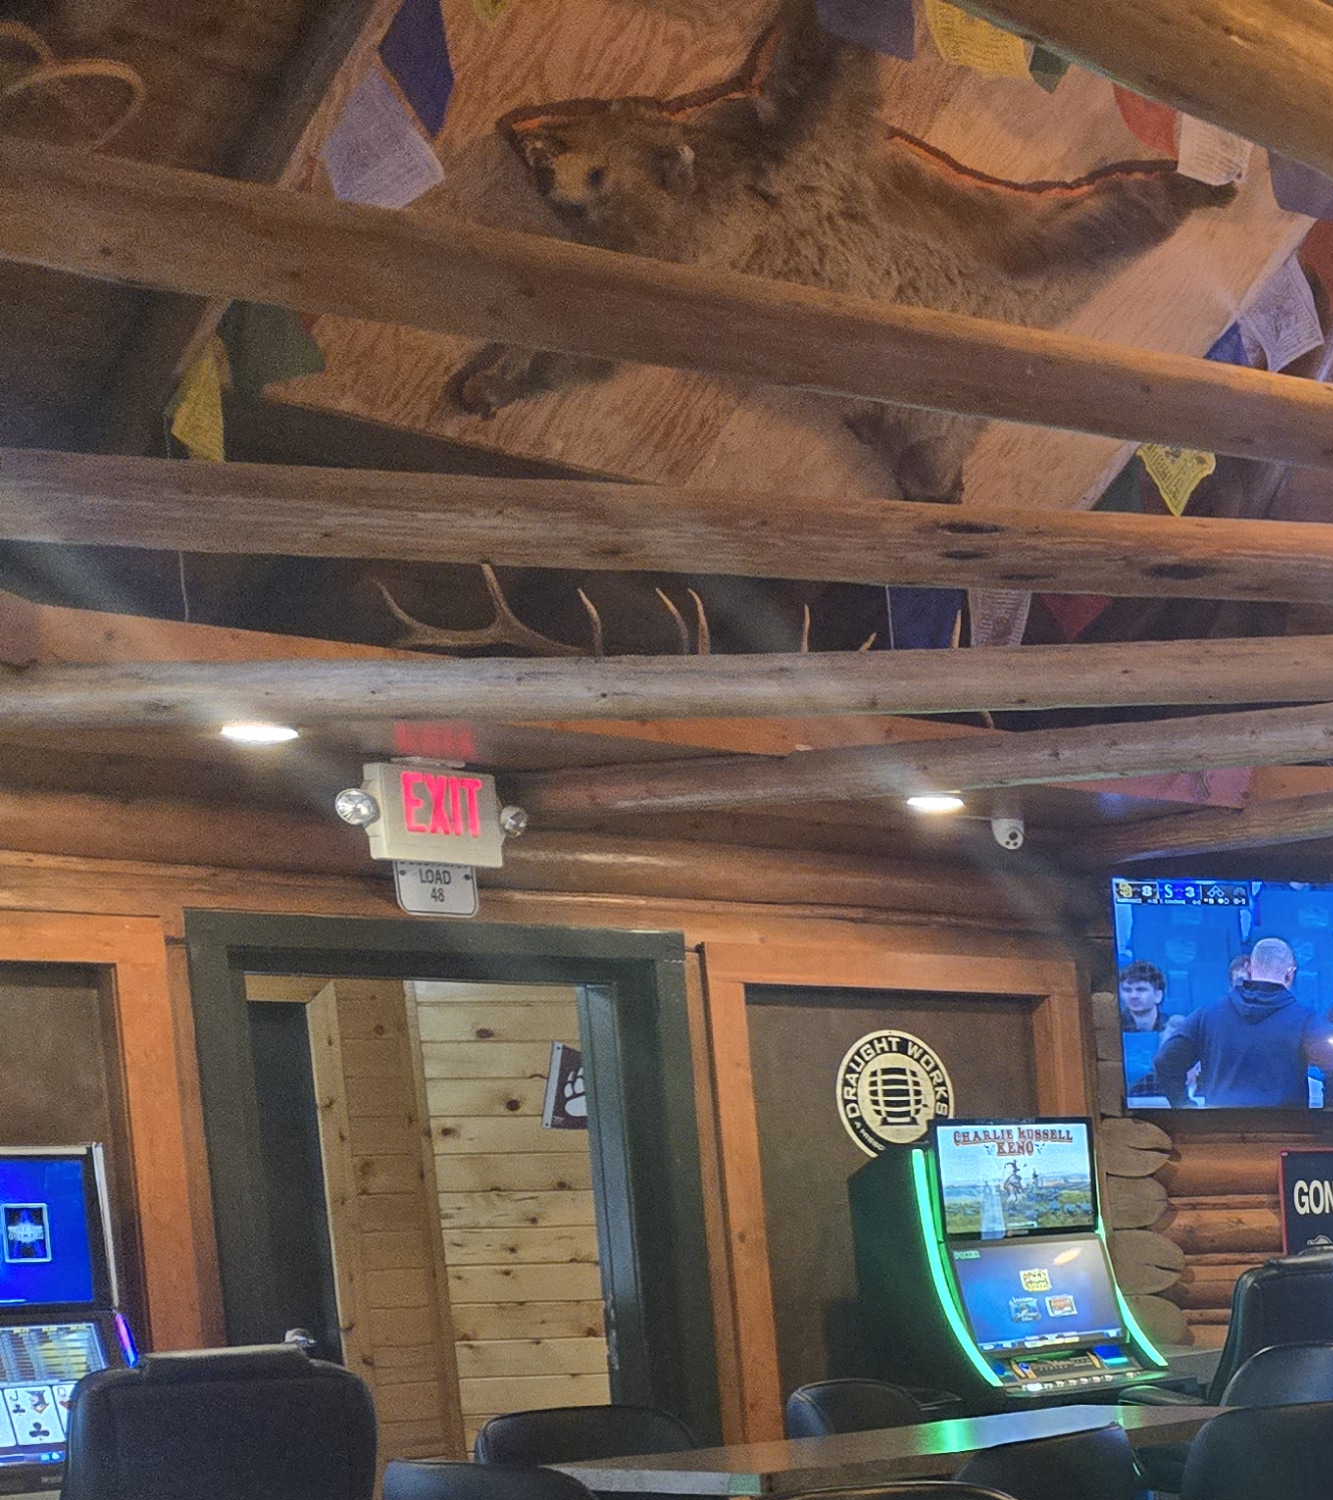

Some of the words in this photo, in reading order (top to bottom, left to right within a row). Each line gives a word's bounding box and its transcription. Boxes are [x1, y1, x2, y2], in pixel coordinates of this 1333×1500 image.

[401, 771, 482, 838] EXIT
[419, 868, 451, 884] LOAD
[431, 887, 446, 902] 48
[844, 1037, 900, 1118] DRAUGHT
[907, 1041, 949, 1116] WORKS
[953, 1128, 1014, 1145] CHARLIE
[1018, 1127, 1073, 1142] RUSSELL
[997, 1141, 1034, 1156] KENO
